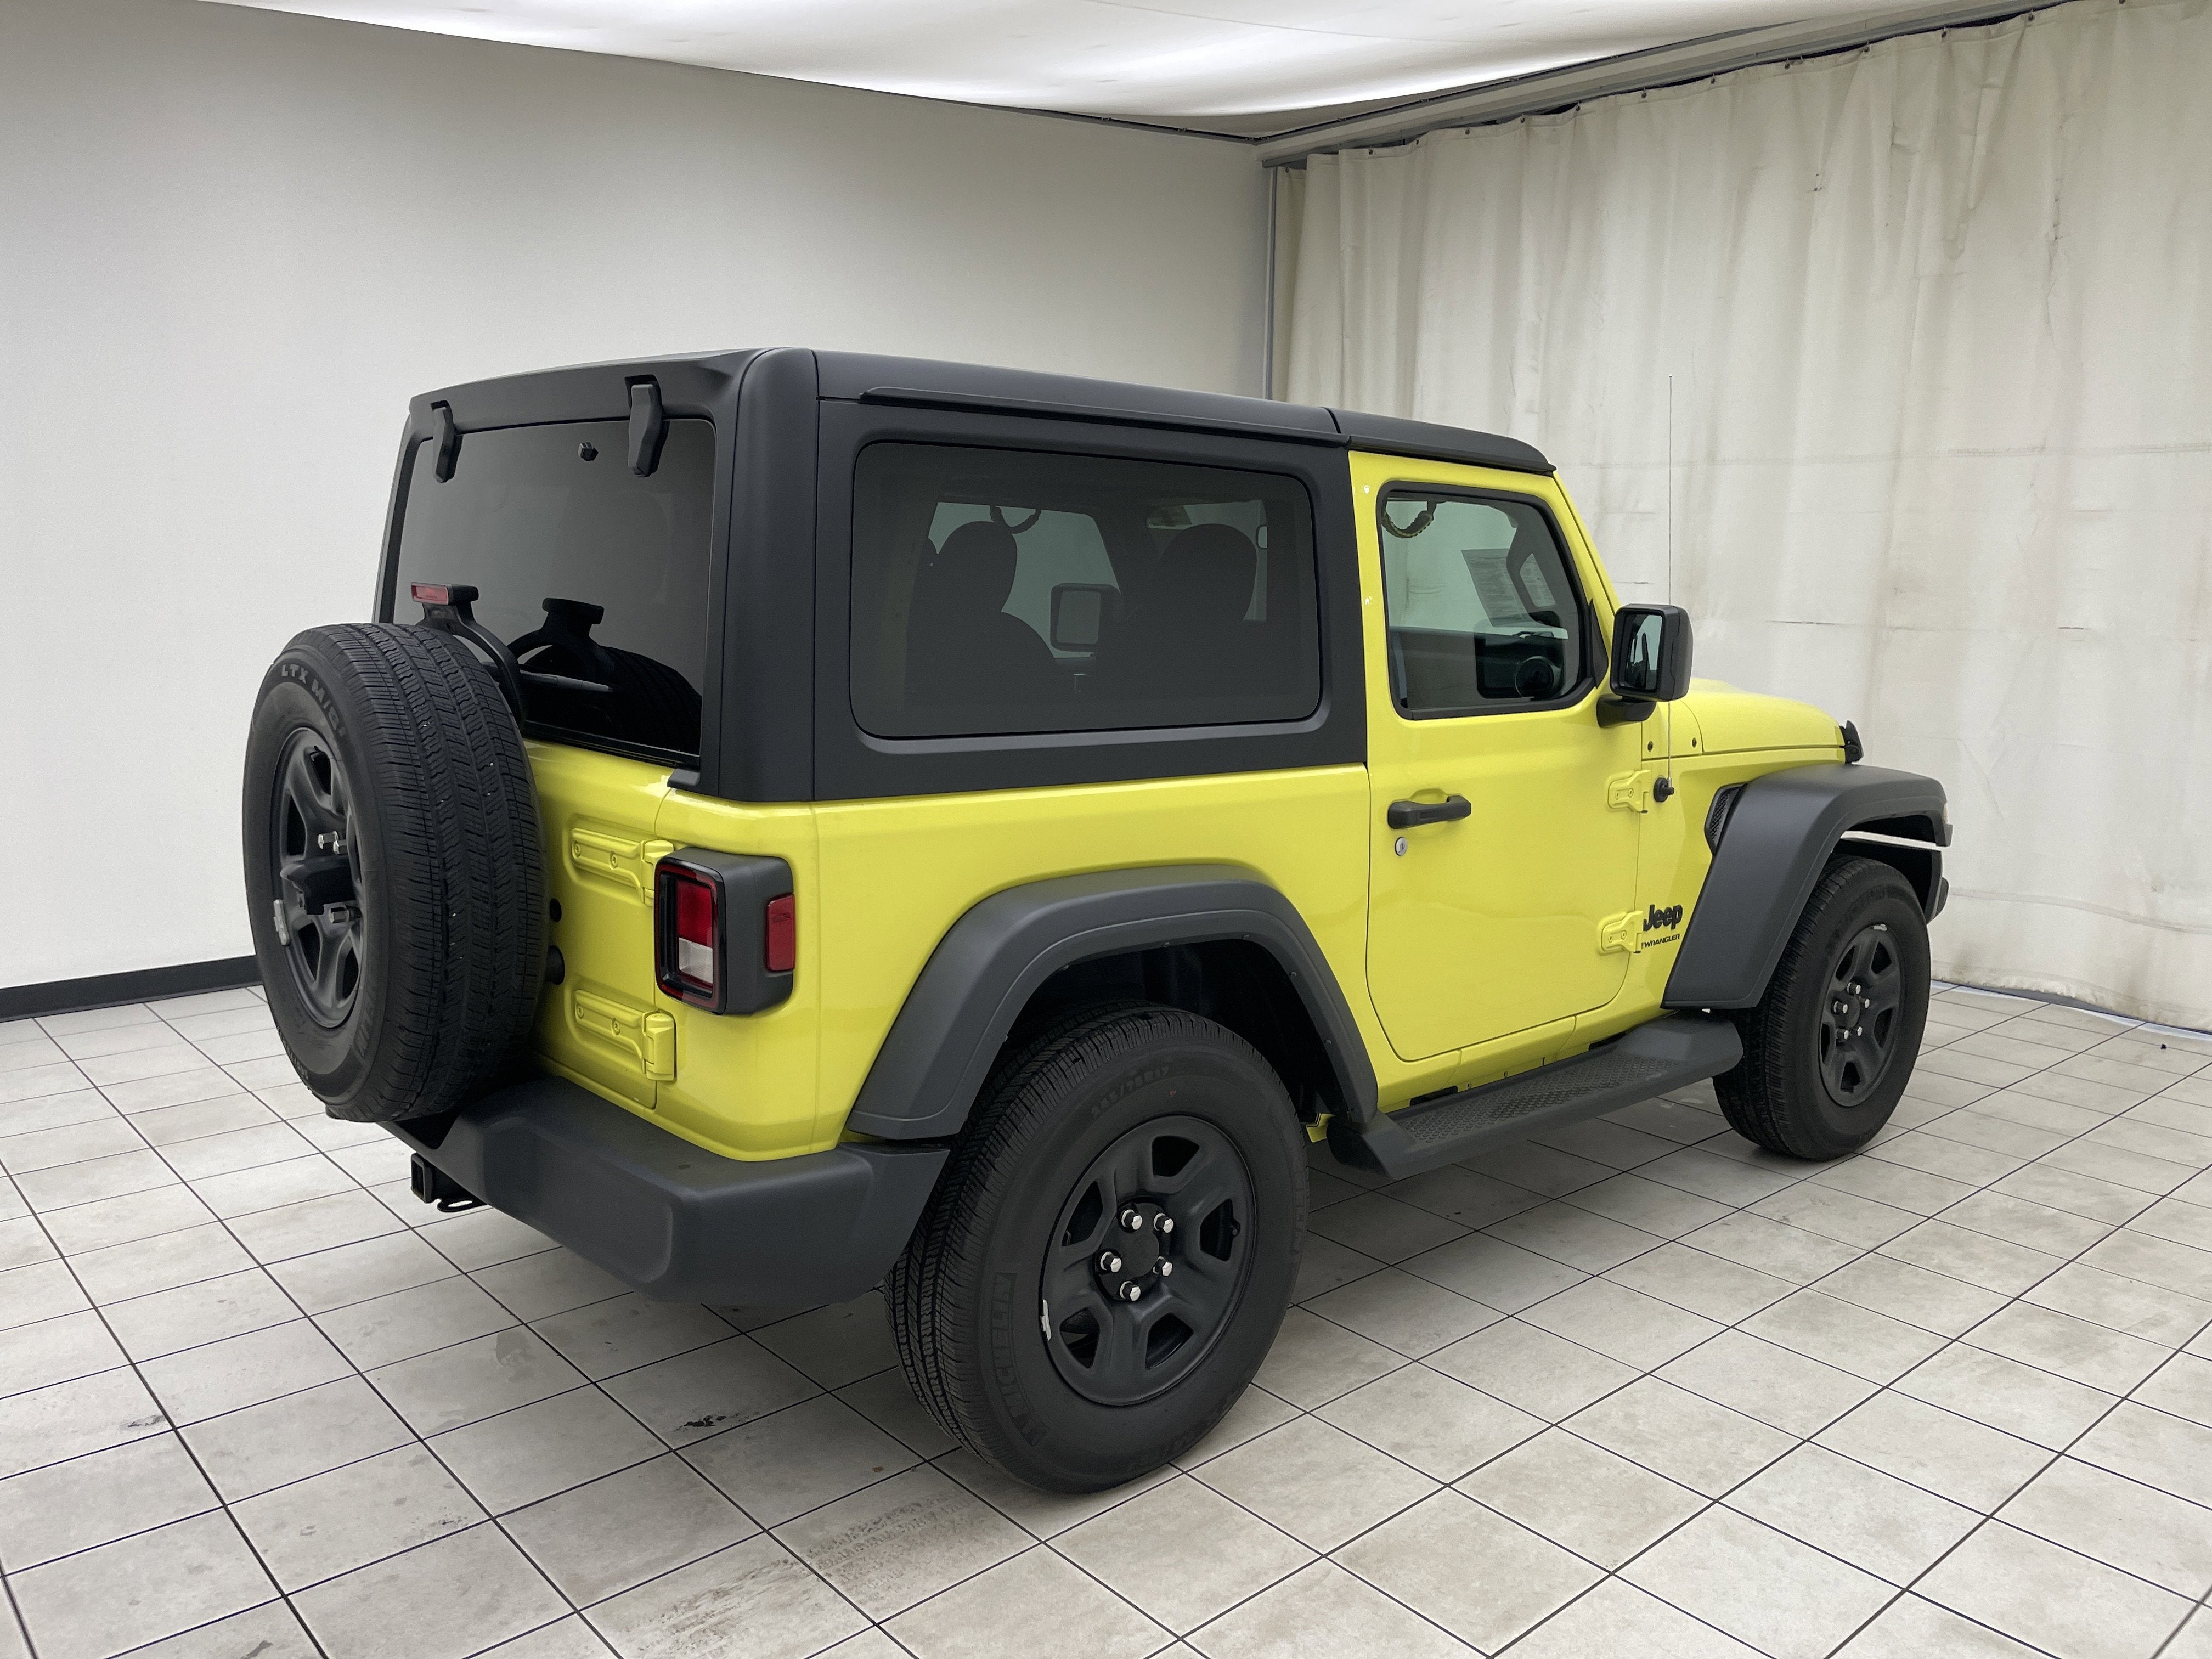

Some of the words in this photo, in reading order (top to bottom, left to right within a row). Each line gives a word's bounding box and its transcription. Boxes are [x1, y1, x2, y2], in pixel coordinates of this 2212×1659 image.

[281, 664, 308, 684] LTX
[1643, 904, 1683, 931] Jeep
[1644, 934, 1680, 948] WRANGLER
[991, 1274, 1029, 1418] MICHELIN
